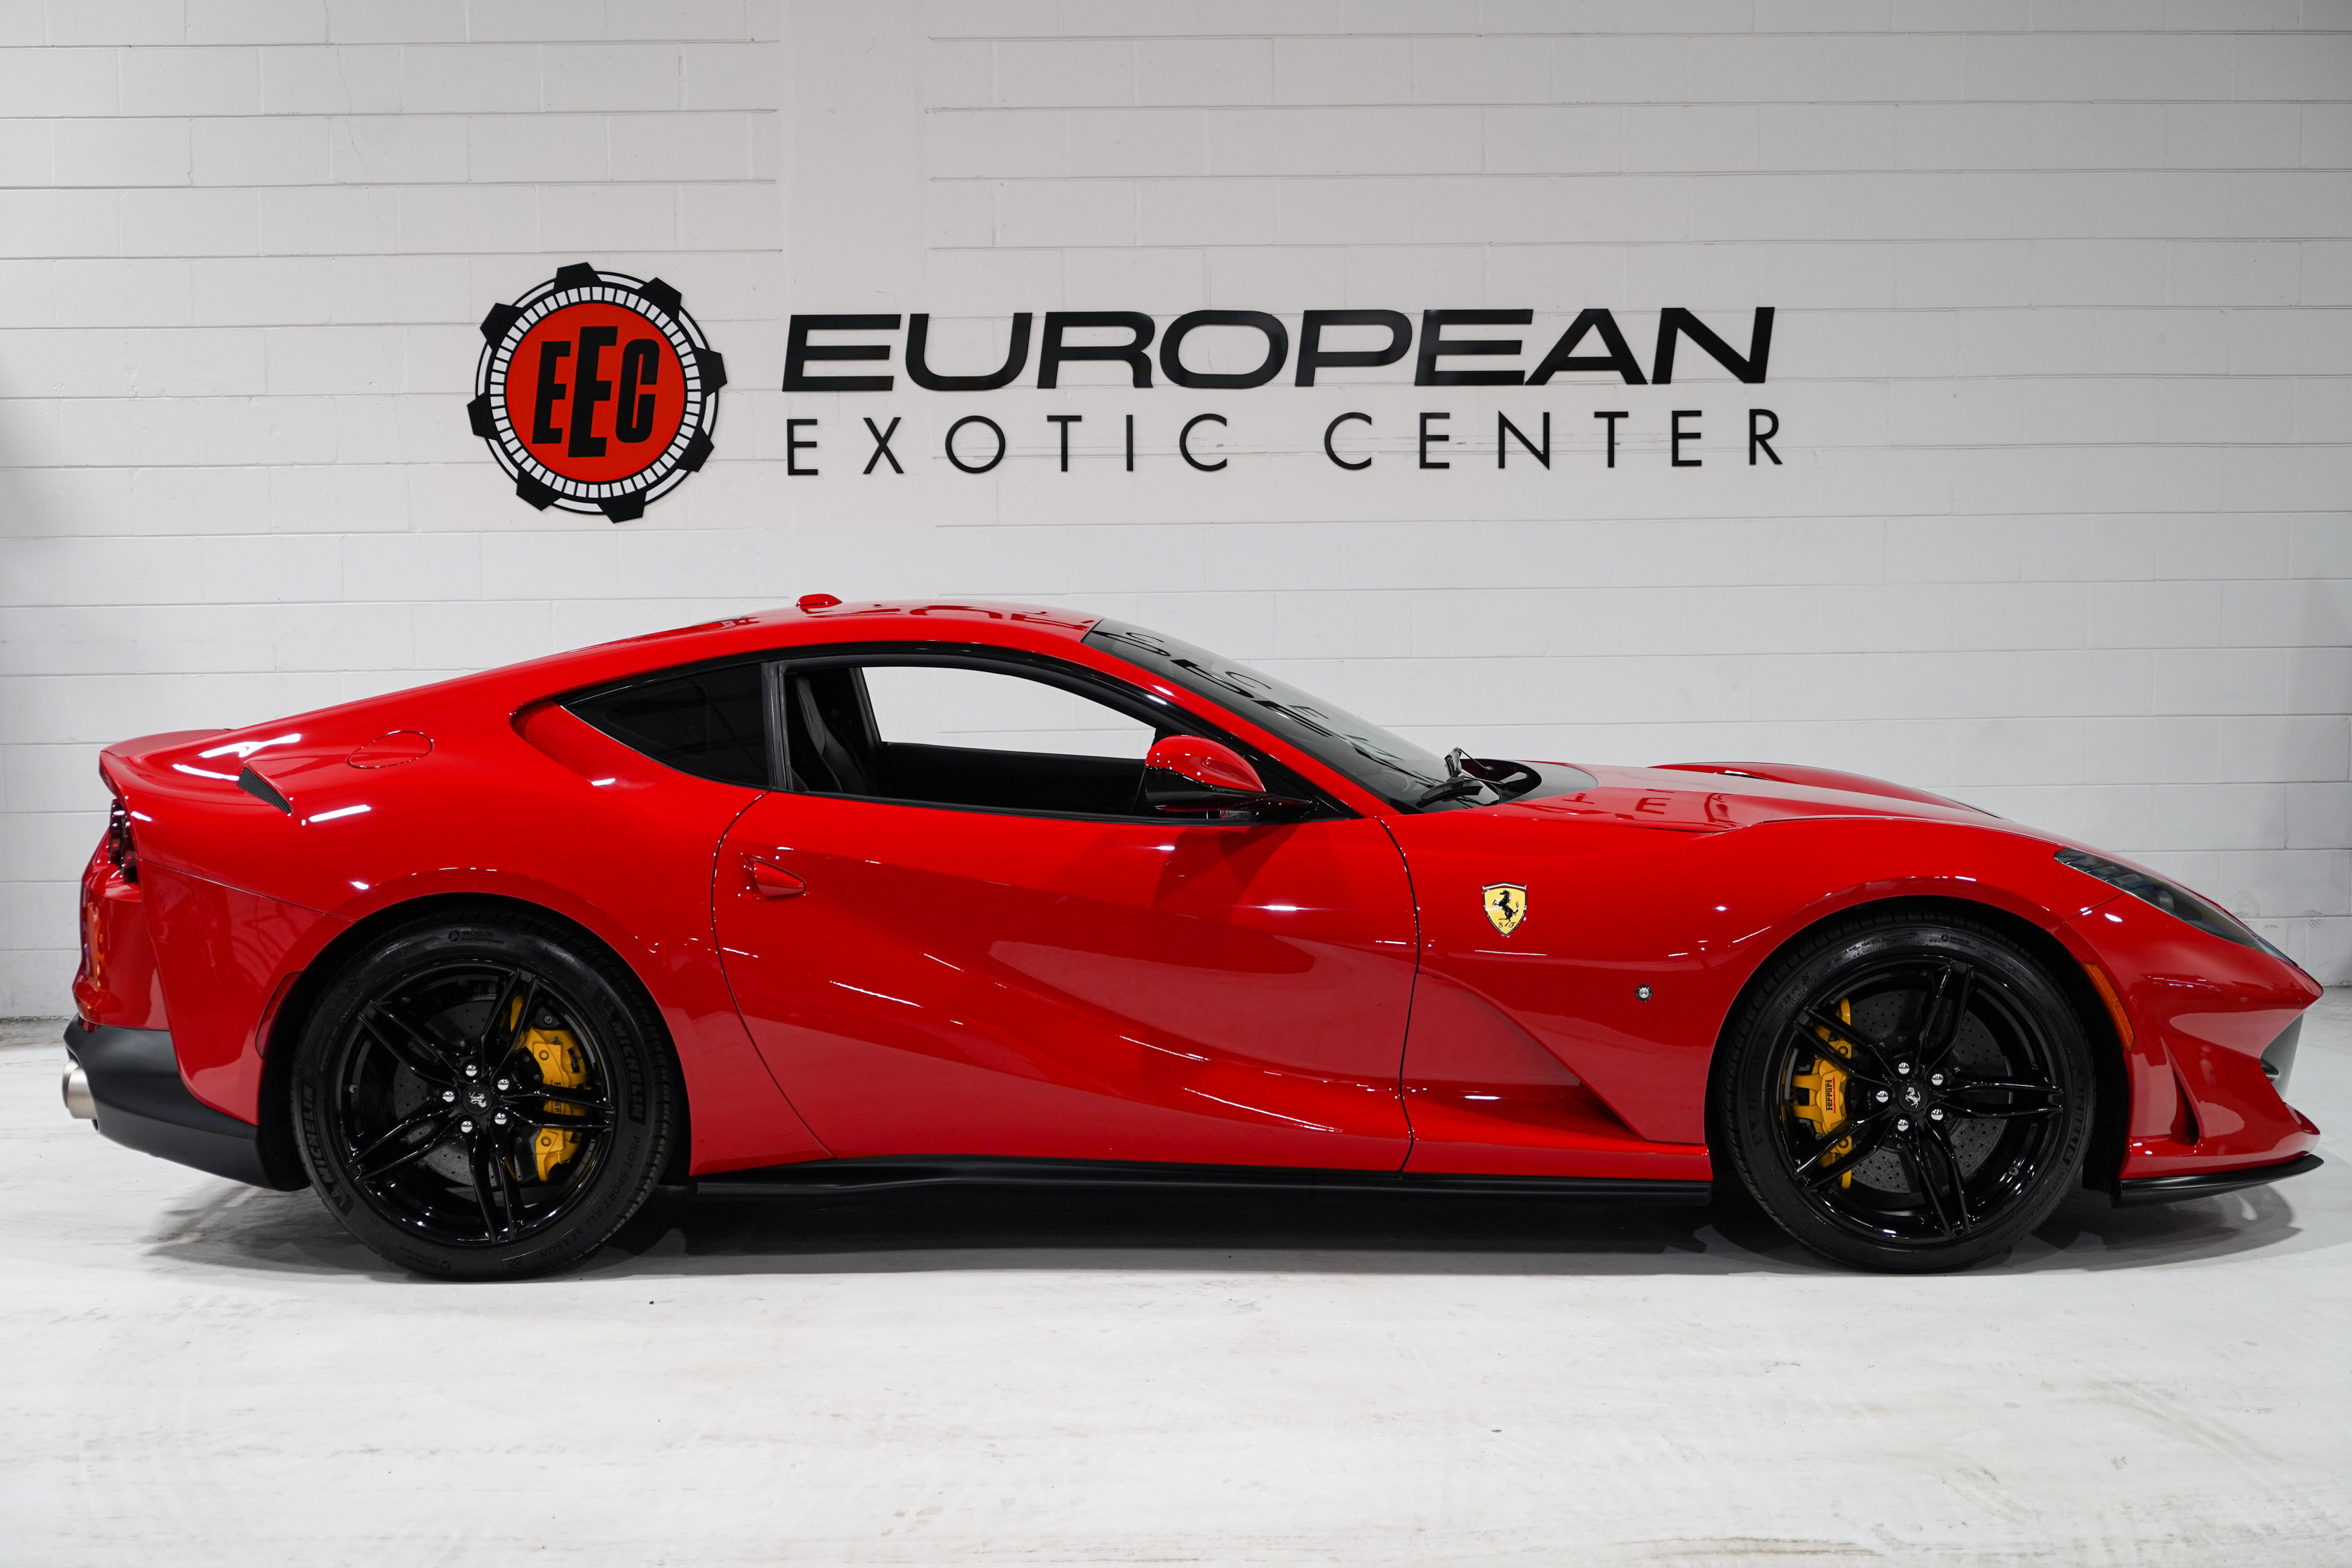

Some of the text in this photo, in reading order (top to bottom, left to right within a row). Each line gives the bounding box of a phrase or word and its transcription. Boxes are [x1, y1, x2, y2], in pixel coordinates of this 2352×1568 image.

[782, 307, 1775, 392] EUROPEAN
[532, 326, 660, 457] EEC
[786, 409, 1783, 476] EXOTIC CENTER
[610, 1018, 643, 1120] MICHELIN
[303, 1085, 334, 1186] MICHELIN
[624, 1135, 641, 1169] PILOT
[584, 1208, 604, 1229] ALL
[601, 1171, 629, 1209] SPORT
[538, 1227, 584, 1259] SEASON
